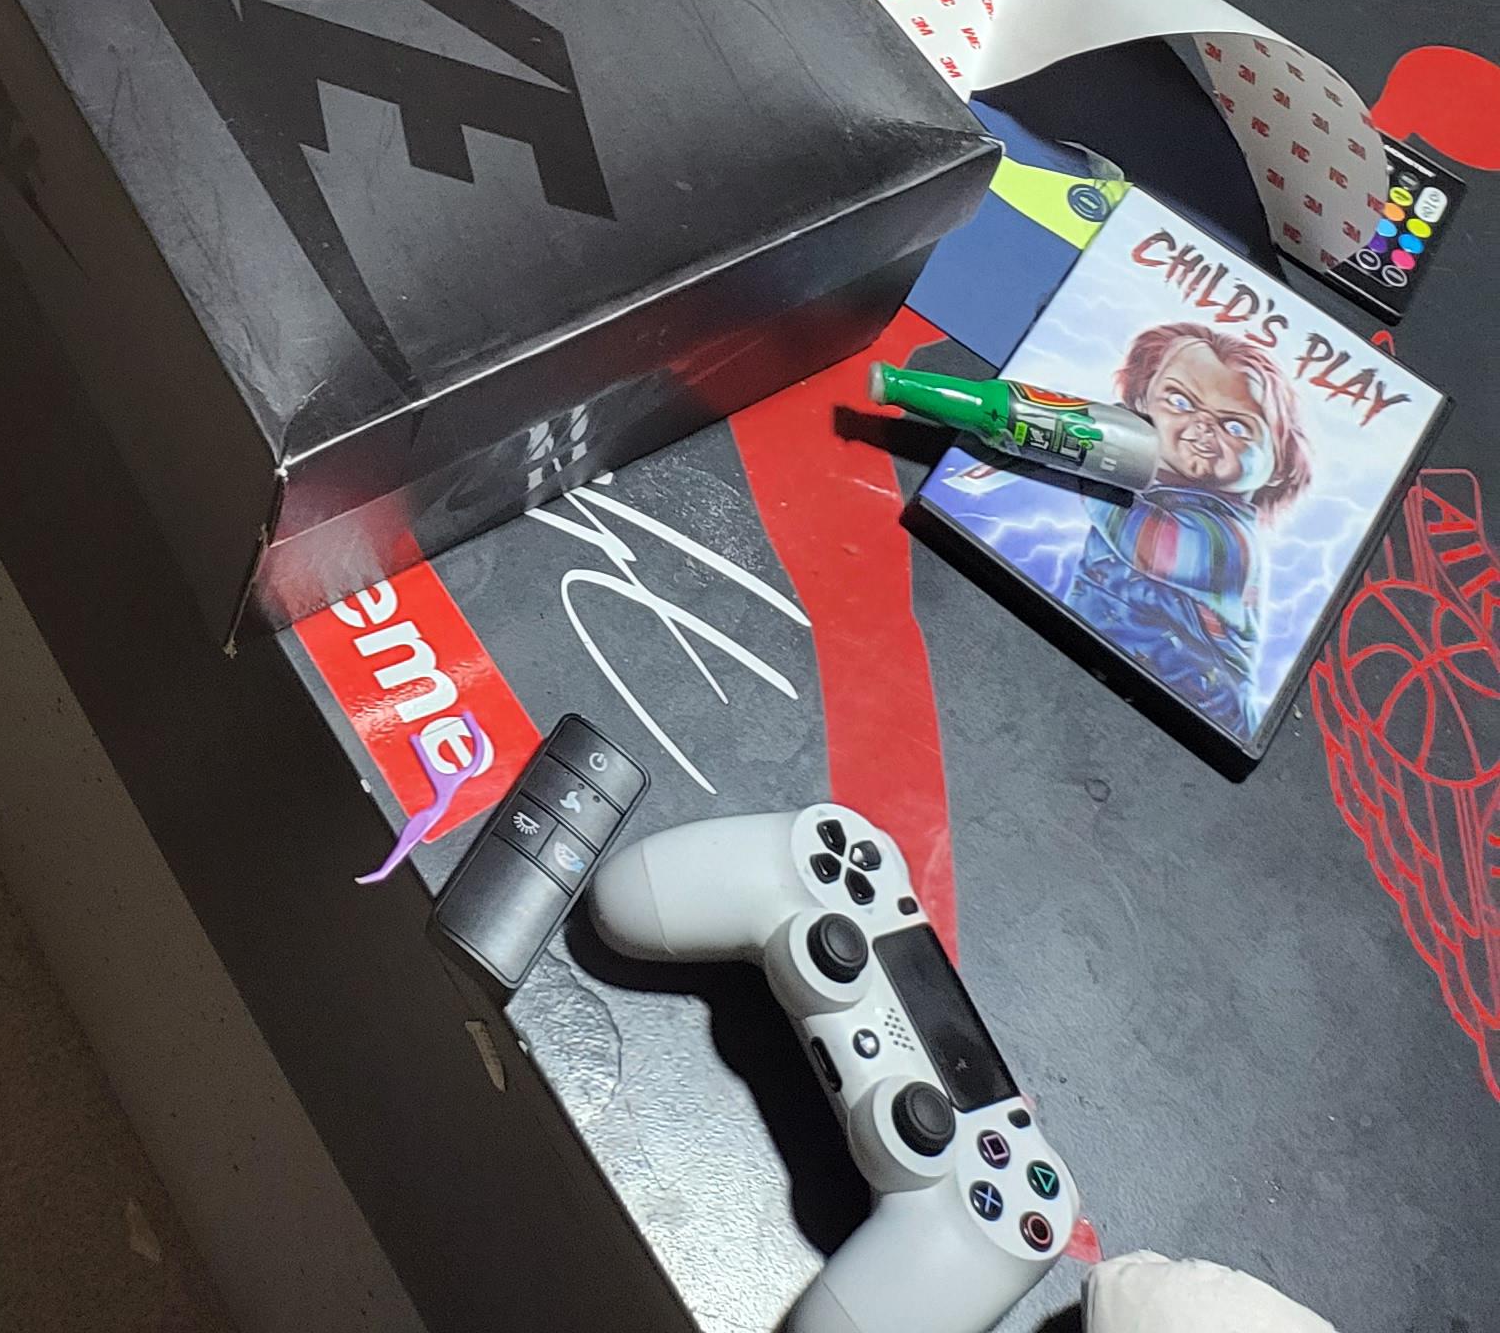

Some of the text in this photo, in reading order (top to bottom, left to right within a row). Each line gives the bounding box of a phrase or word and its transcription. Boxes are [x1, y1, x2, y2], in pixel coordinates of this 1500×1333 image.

[911, 16, 934, 36] 3M
[960, 27, 981, 50] 3M
[940, 56, 964, 78] 3M
[1130, 227, 1412, 427] CHILD'S PLAY
